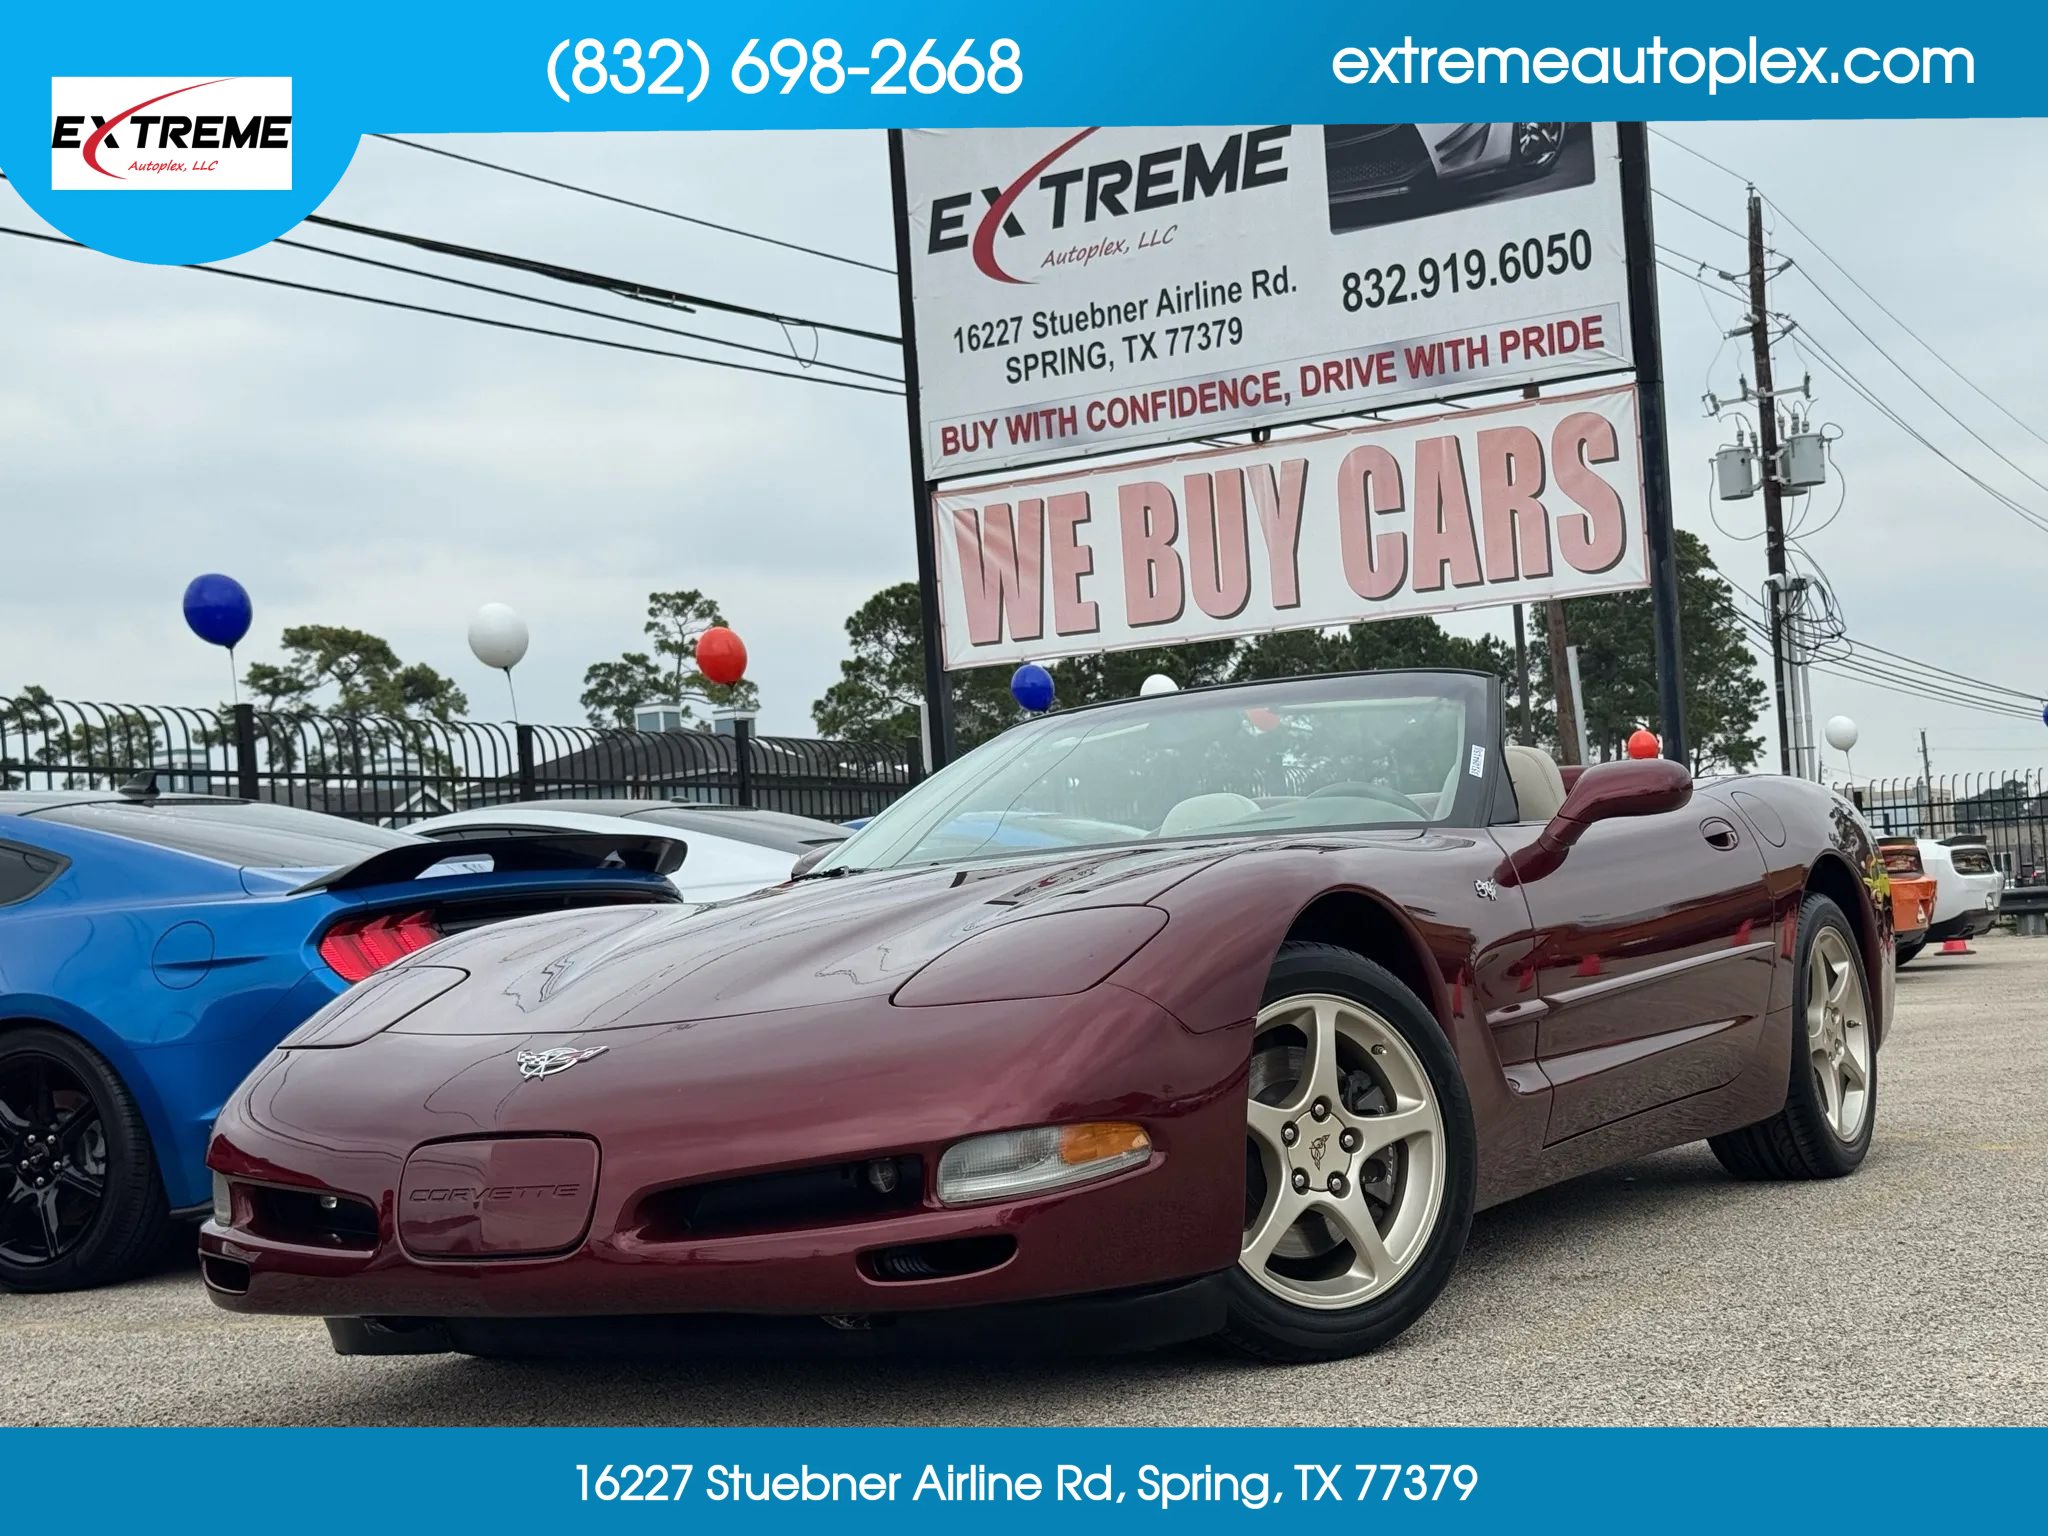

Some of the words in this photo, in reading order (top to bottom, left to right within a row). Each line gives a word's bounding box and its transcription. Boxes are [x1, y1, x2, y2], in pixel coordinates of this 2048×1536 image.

[928, 124, 1292, 255] EXTREME
[1040, 236, 1130, 268] Autoplex,
[1138, 224, 1178, 249] LLC
[1342, 228, 1592, 313] 832.919.6050
[953, 315, 1024, 354] 16227
[1032, 298, 1149, 341] Stuebner
[1156, 280, 1243, 318] Airline
[1251, 264, 1298, 300] Rd.
[1005, 341, 1115, 385] SPRING,
[1122, 331, 1157, 365] TX
[1165, 316, 1243, 356] 77379
[941, 418, 998, 456] BUY
[1005, 405, 1078, 445] WITH
[1086, 372, 1291, 432] CONFIDENCE,
[1300, 350, 1397, 397] DRIVE
[1404, 334, 1489, 379] WITH
[1500, 315, 1605, 364] PRIDE
[953, 490, 1100, 646] WE
[1118, 456, 1309, 628] BUY
[1337, 411, 1628, 601] CARS
[408, 1183, 581, 1202] CORVETTE
